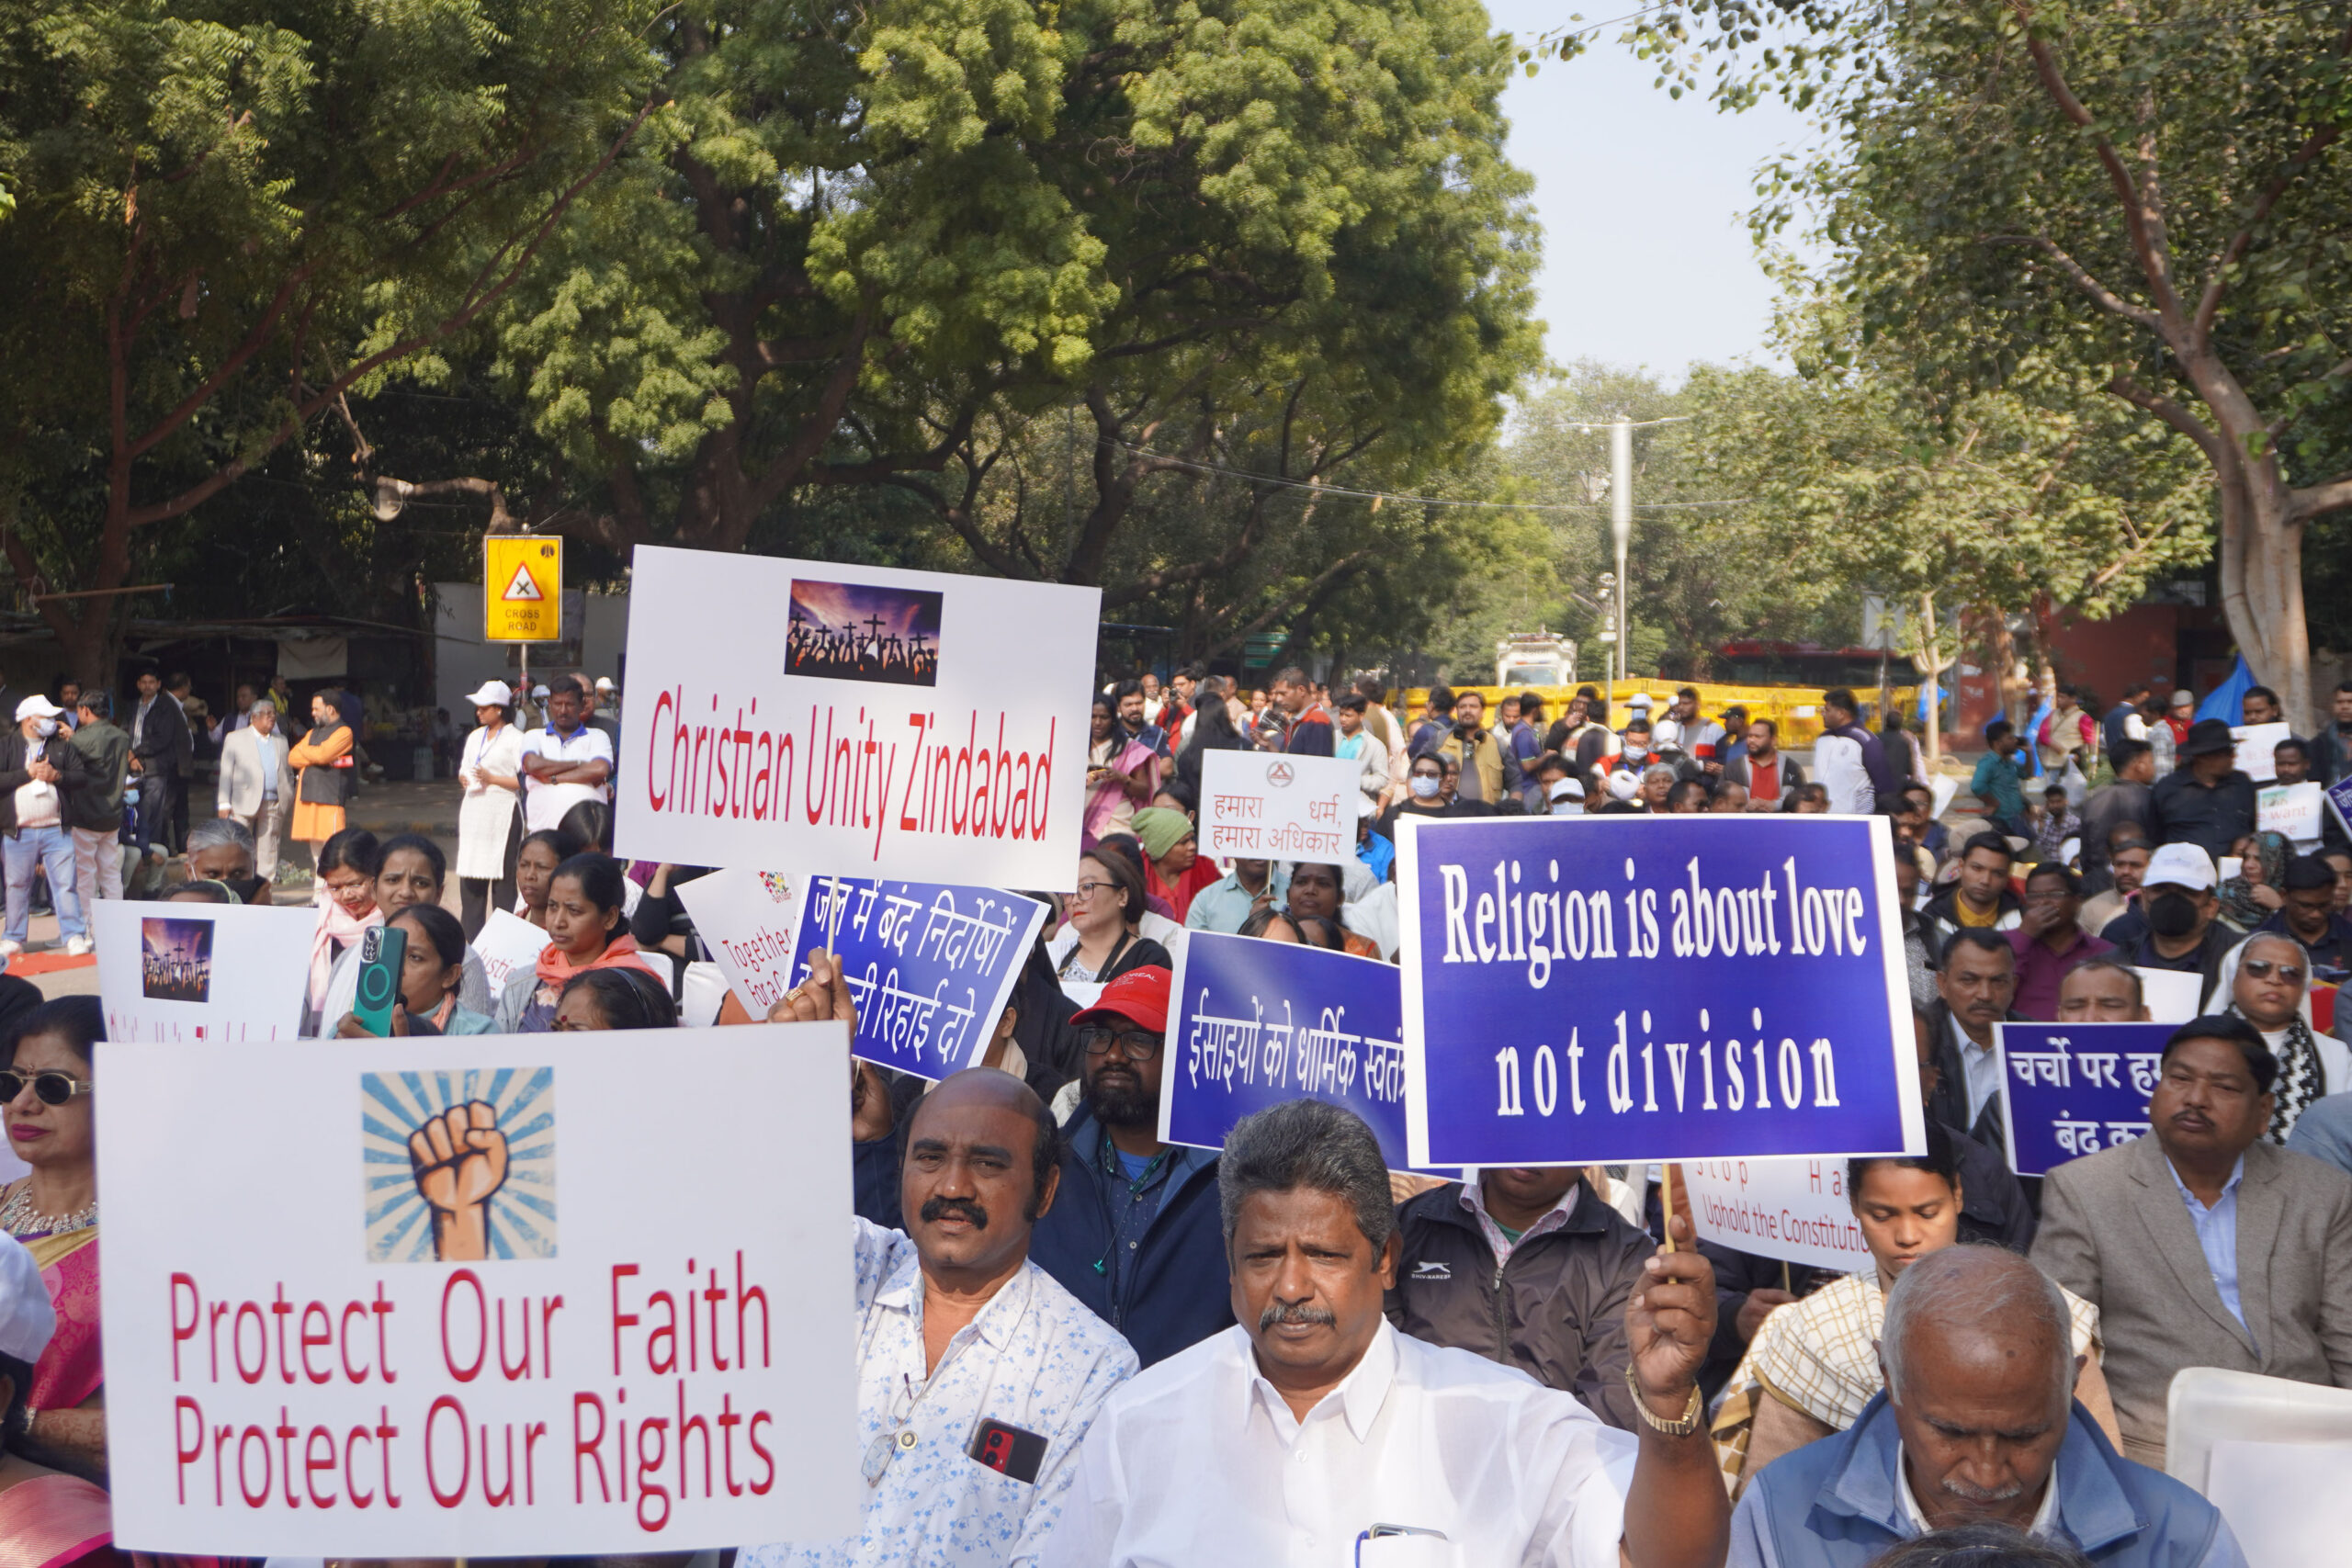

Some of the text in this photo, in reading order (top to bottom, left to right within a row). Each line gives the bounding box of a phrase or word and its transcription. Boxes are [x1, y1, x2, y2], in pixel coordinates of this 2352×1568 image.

[505, 609, 540, 618] CROSS
[508, 622, 537, 631] ROAD
[648, 683, 1056, 862] Christian Unity Zindabad
[1214, 794, 1341, 828] हमारा धर्म,
[1212, 821, 1342, 854] हमारा अधिकार
[878, 884, 922, 957] बंद
[1440, 855, 1868, 989] Religion is about love
[721, 926, 792, 973] Together
[744, 978, 772, 1008] For
[872, 967, 949, 1063] रिहाई
[937, 987, 977, 1065] दो
[1189, 987, 1264, 1094] ईसाइयों
[1263, 999, 1294, 1089] को
[1296, 1006, 1361, 1096] धार्मिक
[1495, 1007, 1841, 1117] not division
[2076, 1053, 2121, 1089] पर
[2052, 1110, 2101, 1156] बंद
[1702, 1193, 1750, 1235] Uphold
[1752, 1201, 1779, 1240] the
[171, 1249, 771, 1385] Protect Our Faith
[175, 1378, 775, 1532] Protect Our Rights
